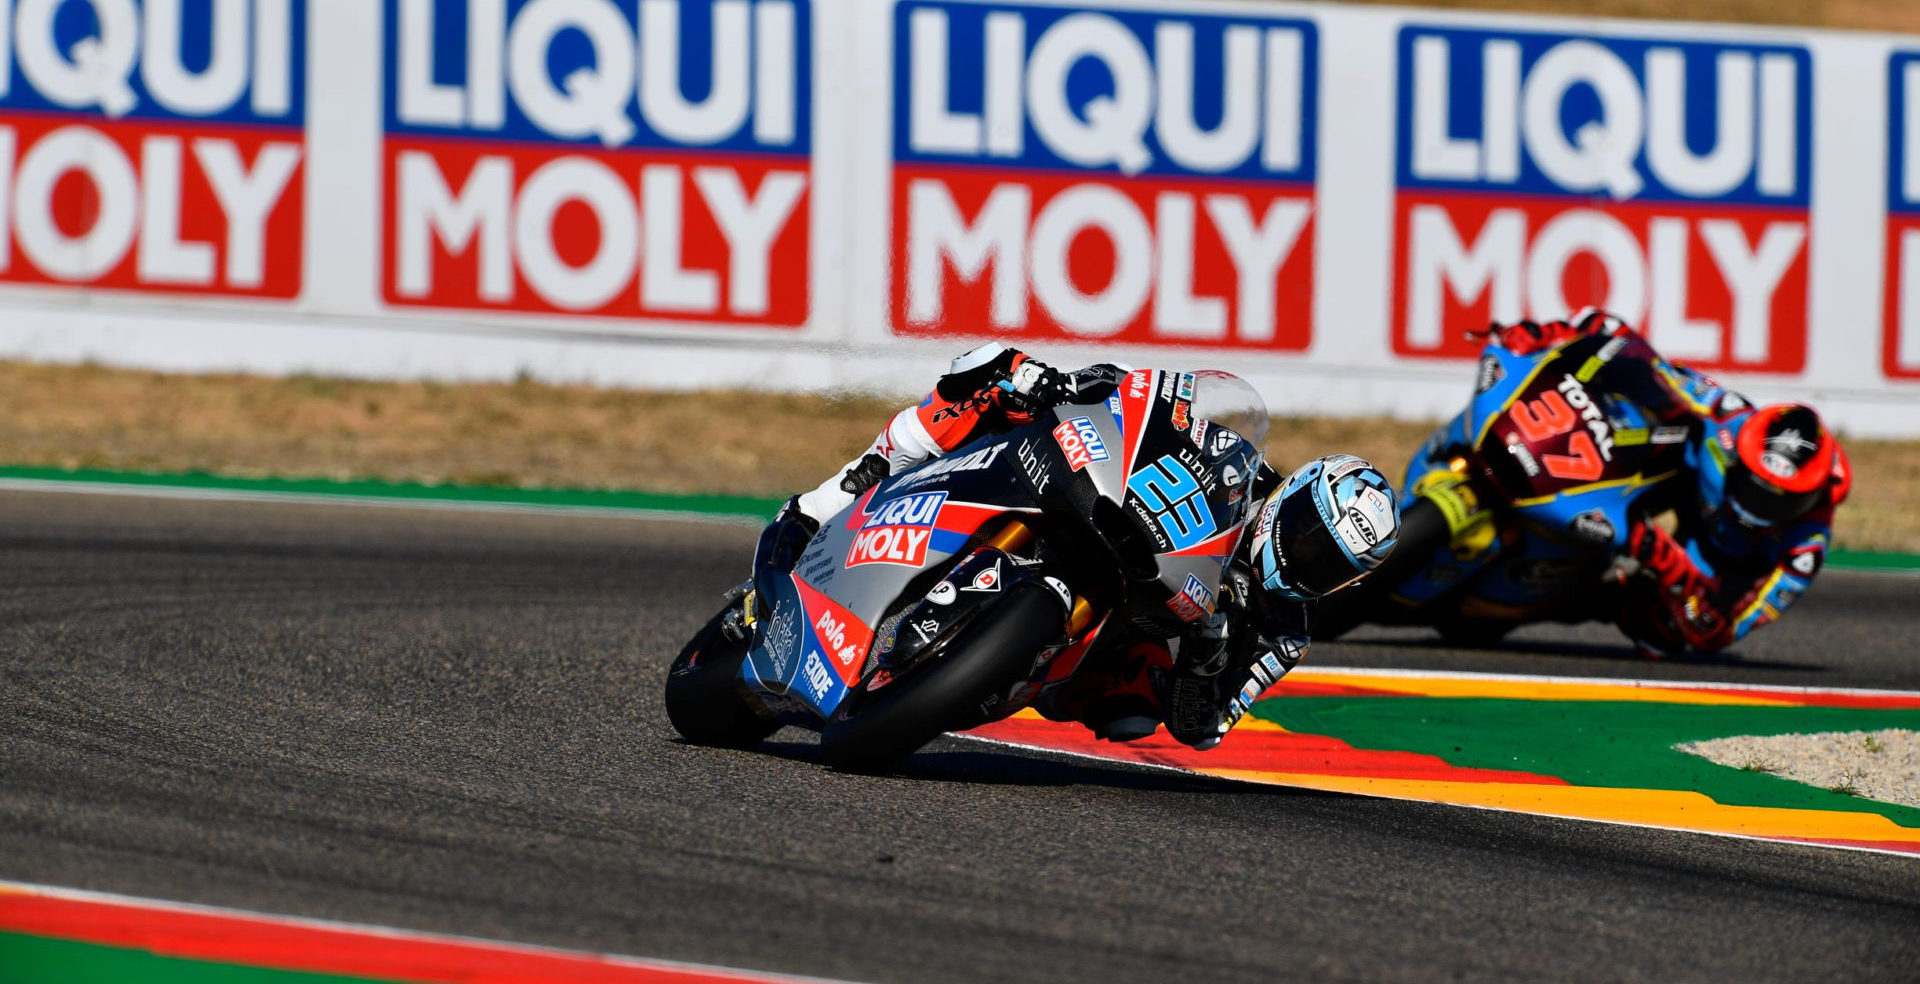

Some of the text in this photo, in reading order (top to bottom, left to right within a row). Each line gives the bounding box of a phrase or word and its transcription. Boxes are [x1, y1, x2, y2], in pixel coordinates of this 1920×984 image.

[0, 0, 291, 117] QUI
[397, 0, 795, 148] LIQUI
[910, 8, 1303, 176] LIQUI
[1411, 35, 1797, 202] LIQUI
[0, 125, 302, 287] OLY
[397, 150, 807, 316] MOLY
[908, 178, 1312, 341] MOLY
[1406, 204, 1807, 363] MOLY
[1055, 423, 1090, 467] MOLY
[1072, 418, 1109, 461] LIQUI
[1509, 389, 1604, 481] 37
[1557, 373, 1613, 462] TOTAL
[850, 528, 929, 562] MOLY
[866, 493, 940, 527] LIQUI
[1128, 454, 1217, 550] 23
[1351, 512, 1377, 543] HJC
[816, 609, 846, 651] polo
[1185, 576, 1213, 609] LIQUI
[804, 650, 834, 699] EXIDE
